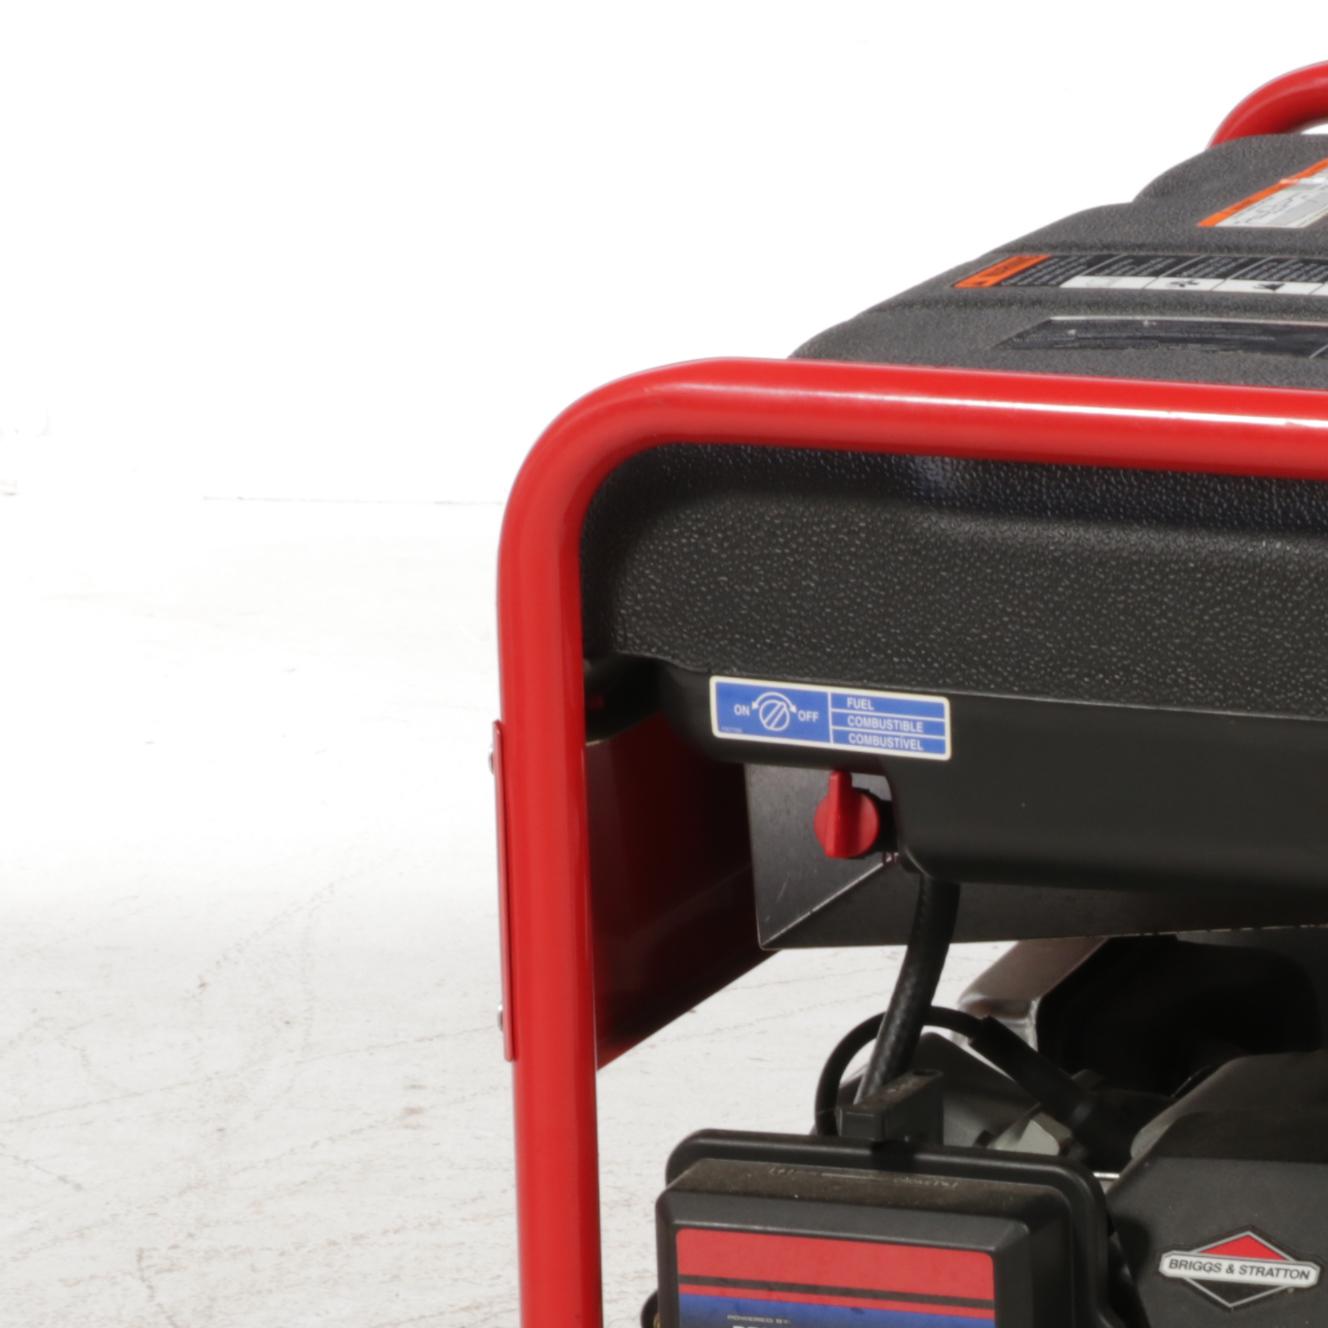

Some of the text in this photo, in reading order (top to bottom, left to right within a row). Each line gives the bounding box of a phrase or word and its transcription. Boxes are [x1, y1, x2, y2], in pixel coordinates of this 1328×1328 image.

[734, 703, 819, 723] ON OFF
[847, 697, 875, 711] FUEL
[847, 714, 925, 733] COMBUSTIBLE
[848, 732, 924, 751] COMBUSTÍVEL
[1168, 1257, 1310, 1281] BRIGGS & STRATTON
